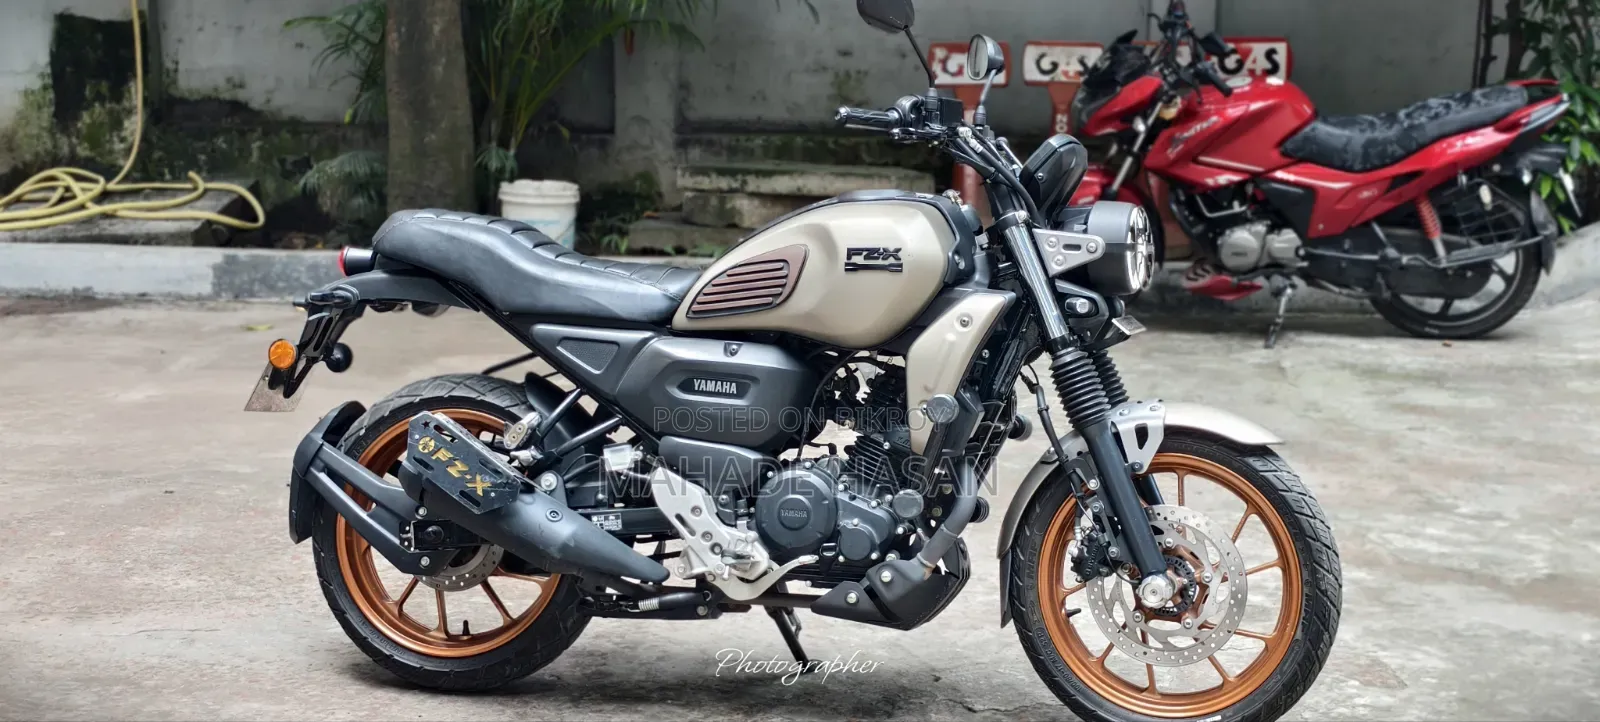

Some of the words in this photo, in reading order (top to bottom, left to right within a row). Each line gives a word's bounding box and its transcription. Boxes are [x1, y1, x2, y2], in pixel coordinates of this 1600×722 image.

[1218, 47, 1280, 76] G4S
[846, 247, 902, 261] FZ-X
[693, 378, 738, 395] YAMAHA
[431, 447, 492, 497] FZ-X
[780, 508, 808, 518] YAMAHA
